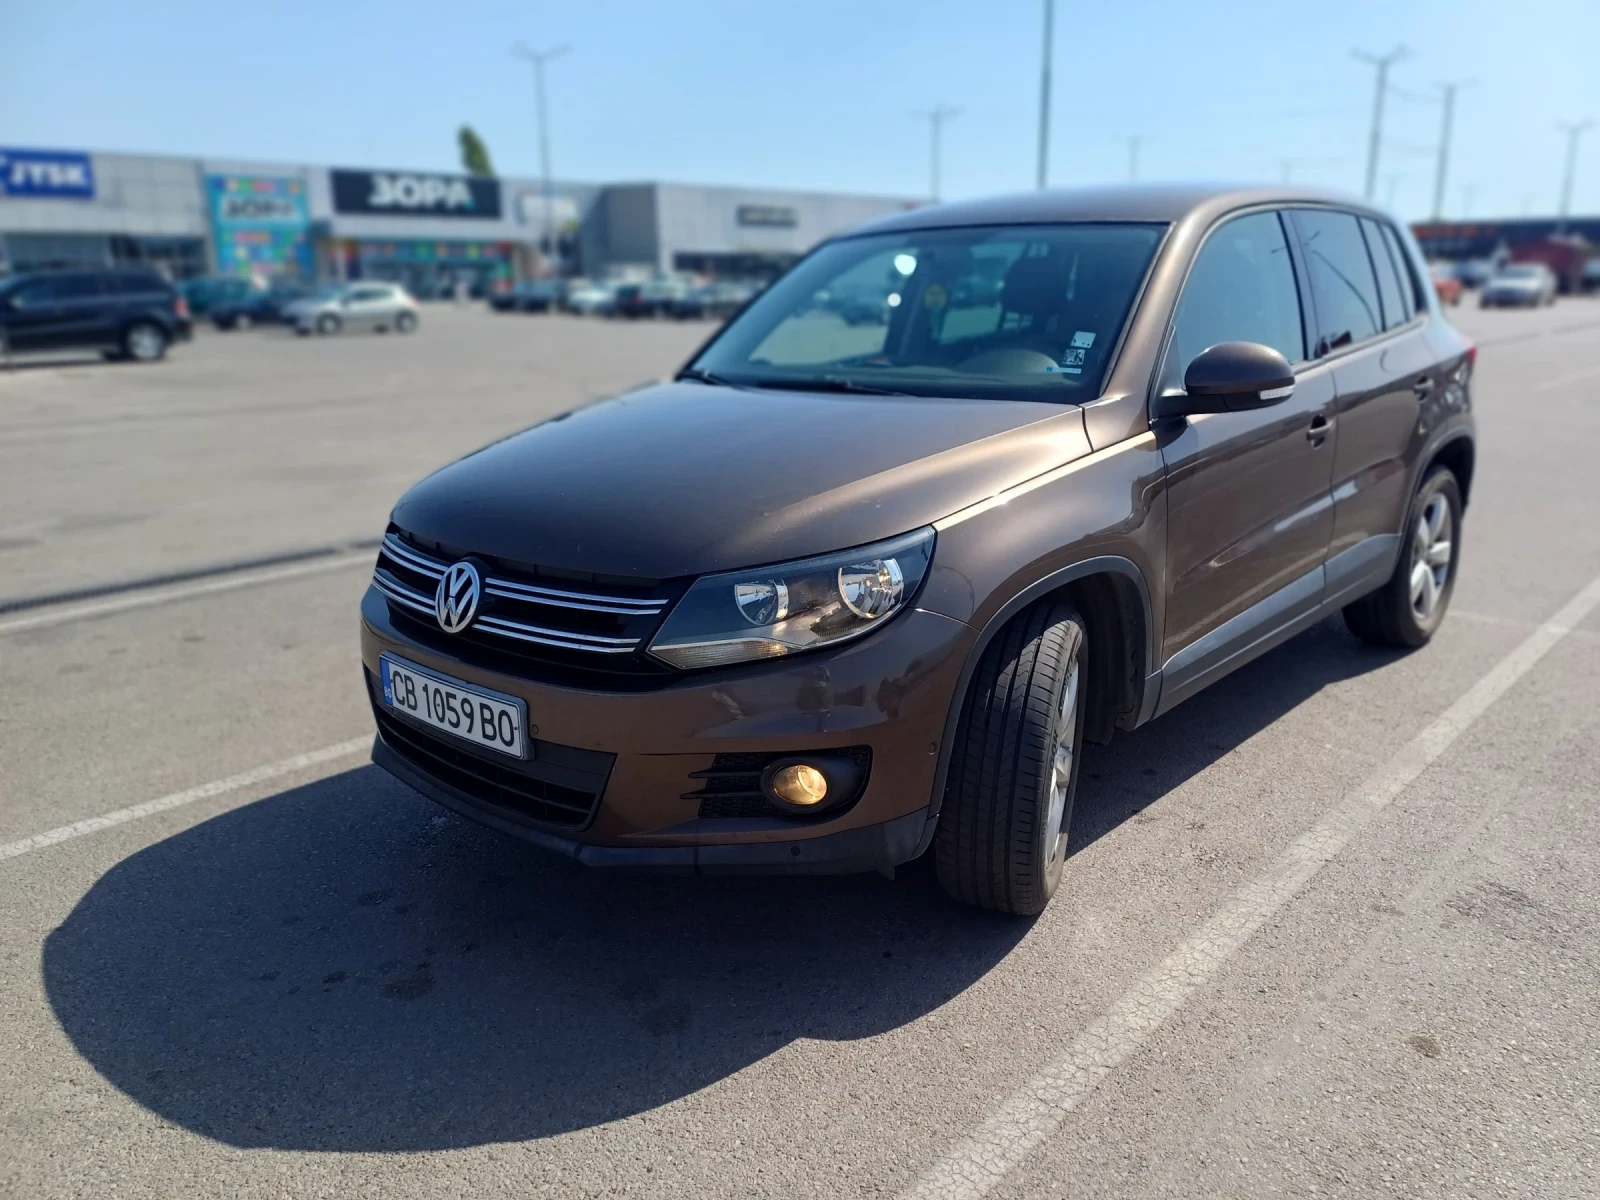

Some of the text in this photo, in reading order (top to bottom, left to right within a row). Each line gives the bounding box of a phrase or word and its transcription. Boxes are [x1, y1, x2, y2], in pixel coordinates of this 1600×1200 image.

[11, 161, 87, 188] JYSK
[367, 174, 473, 211] ЗОРА
[422, 683, 475, 734] 1059
